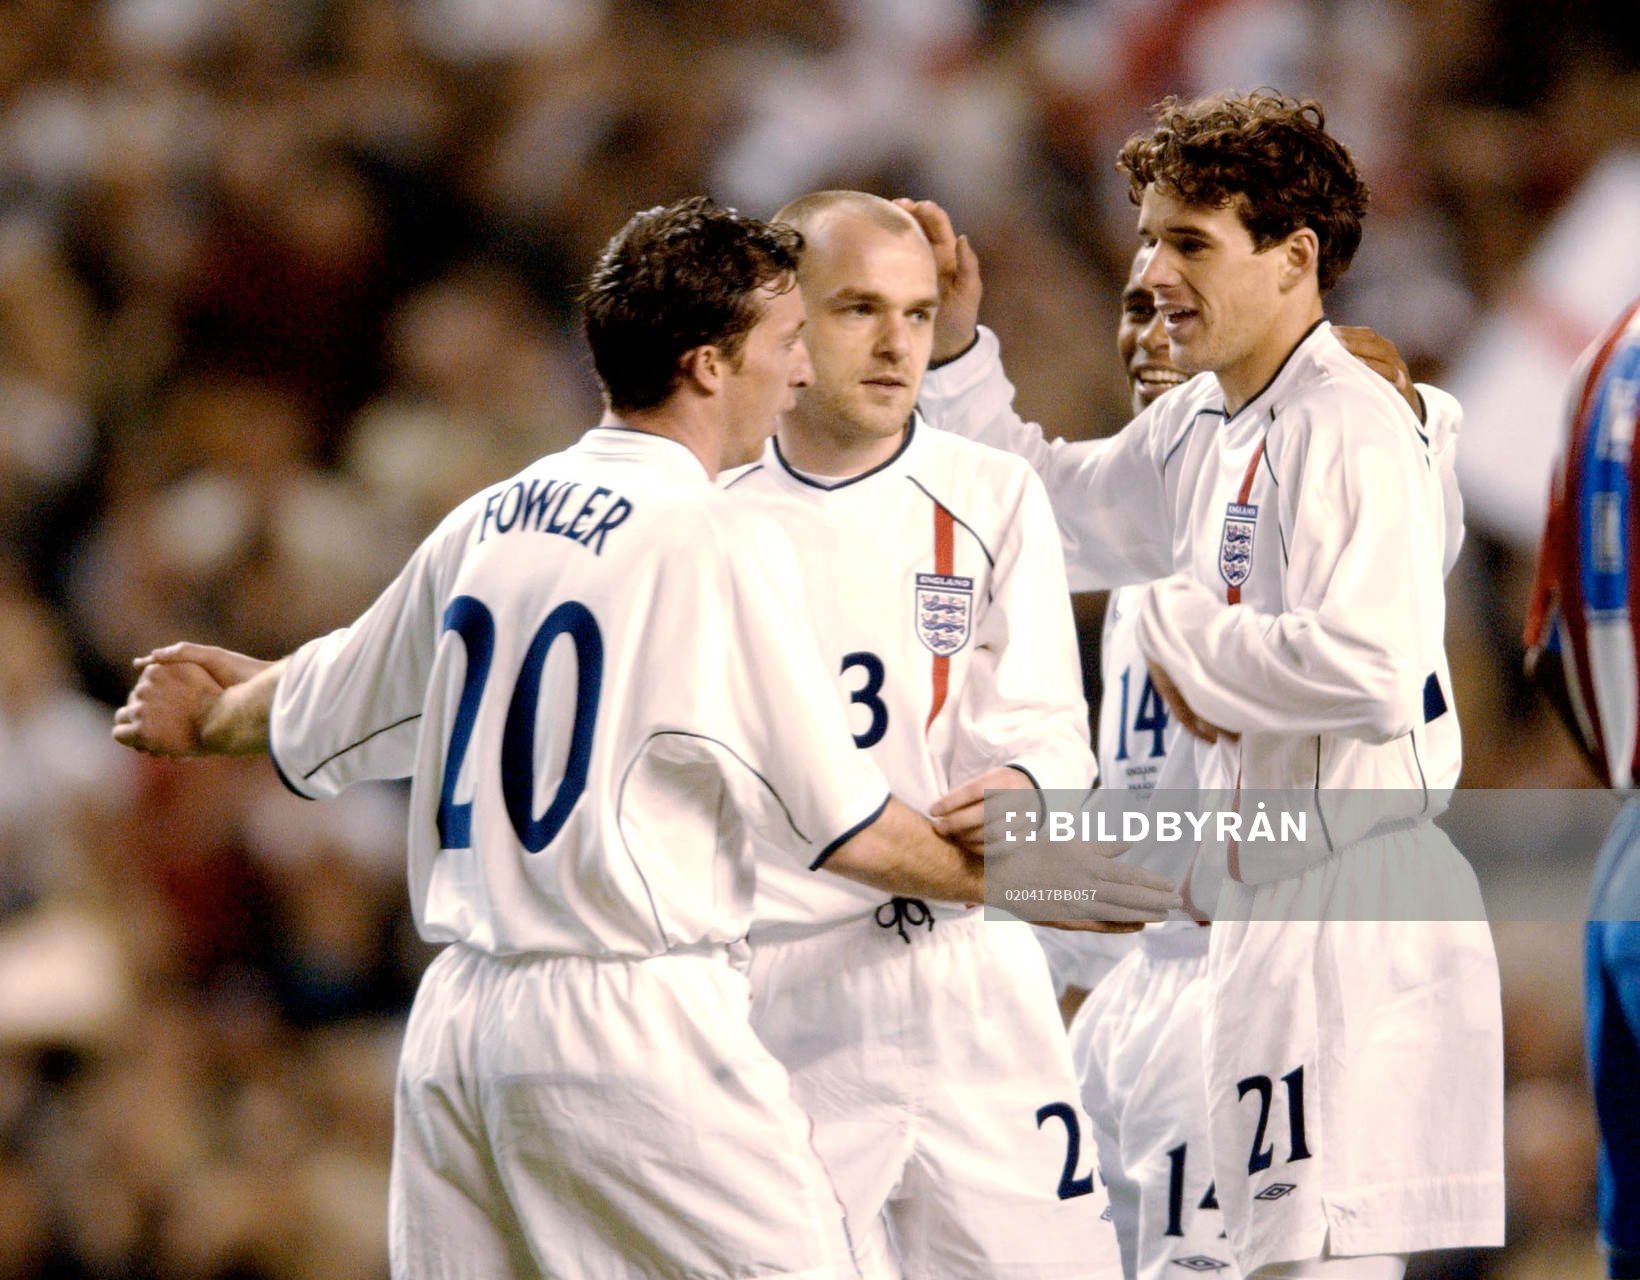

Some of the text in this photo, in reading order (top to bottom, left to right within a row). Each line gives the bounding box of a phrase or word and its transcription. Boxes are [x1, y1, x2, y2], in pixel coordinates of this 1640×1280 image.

[479, 479, 634, 556] FOWLER
[919, 575, 970, 587] ENGLAND
[436, 595, 604, 853] 20
[1115, 664, 1169, 760] 14
[1237, 1064, 1312, 1176] 21
